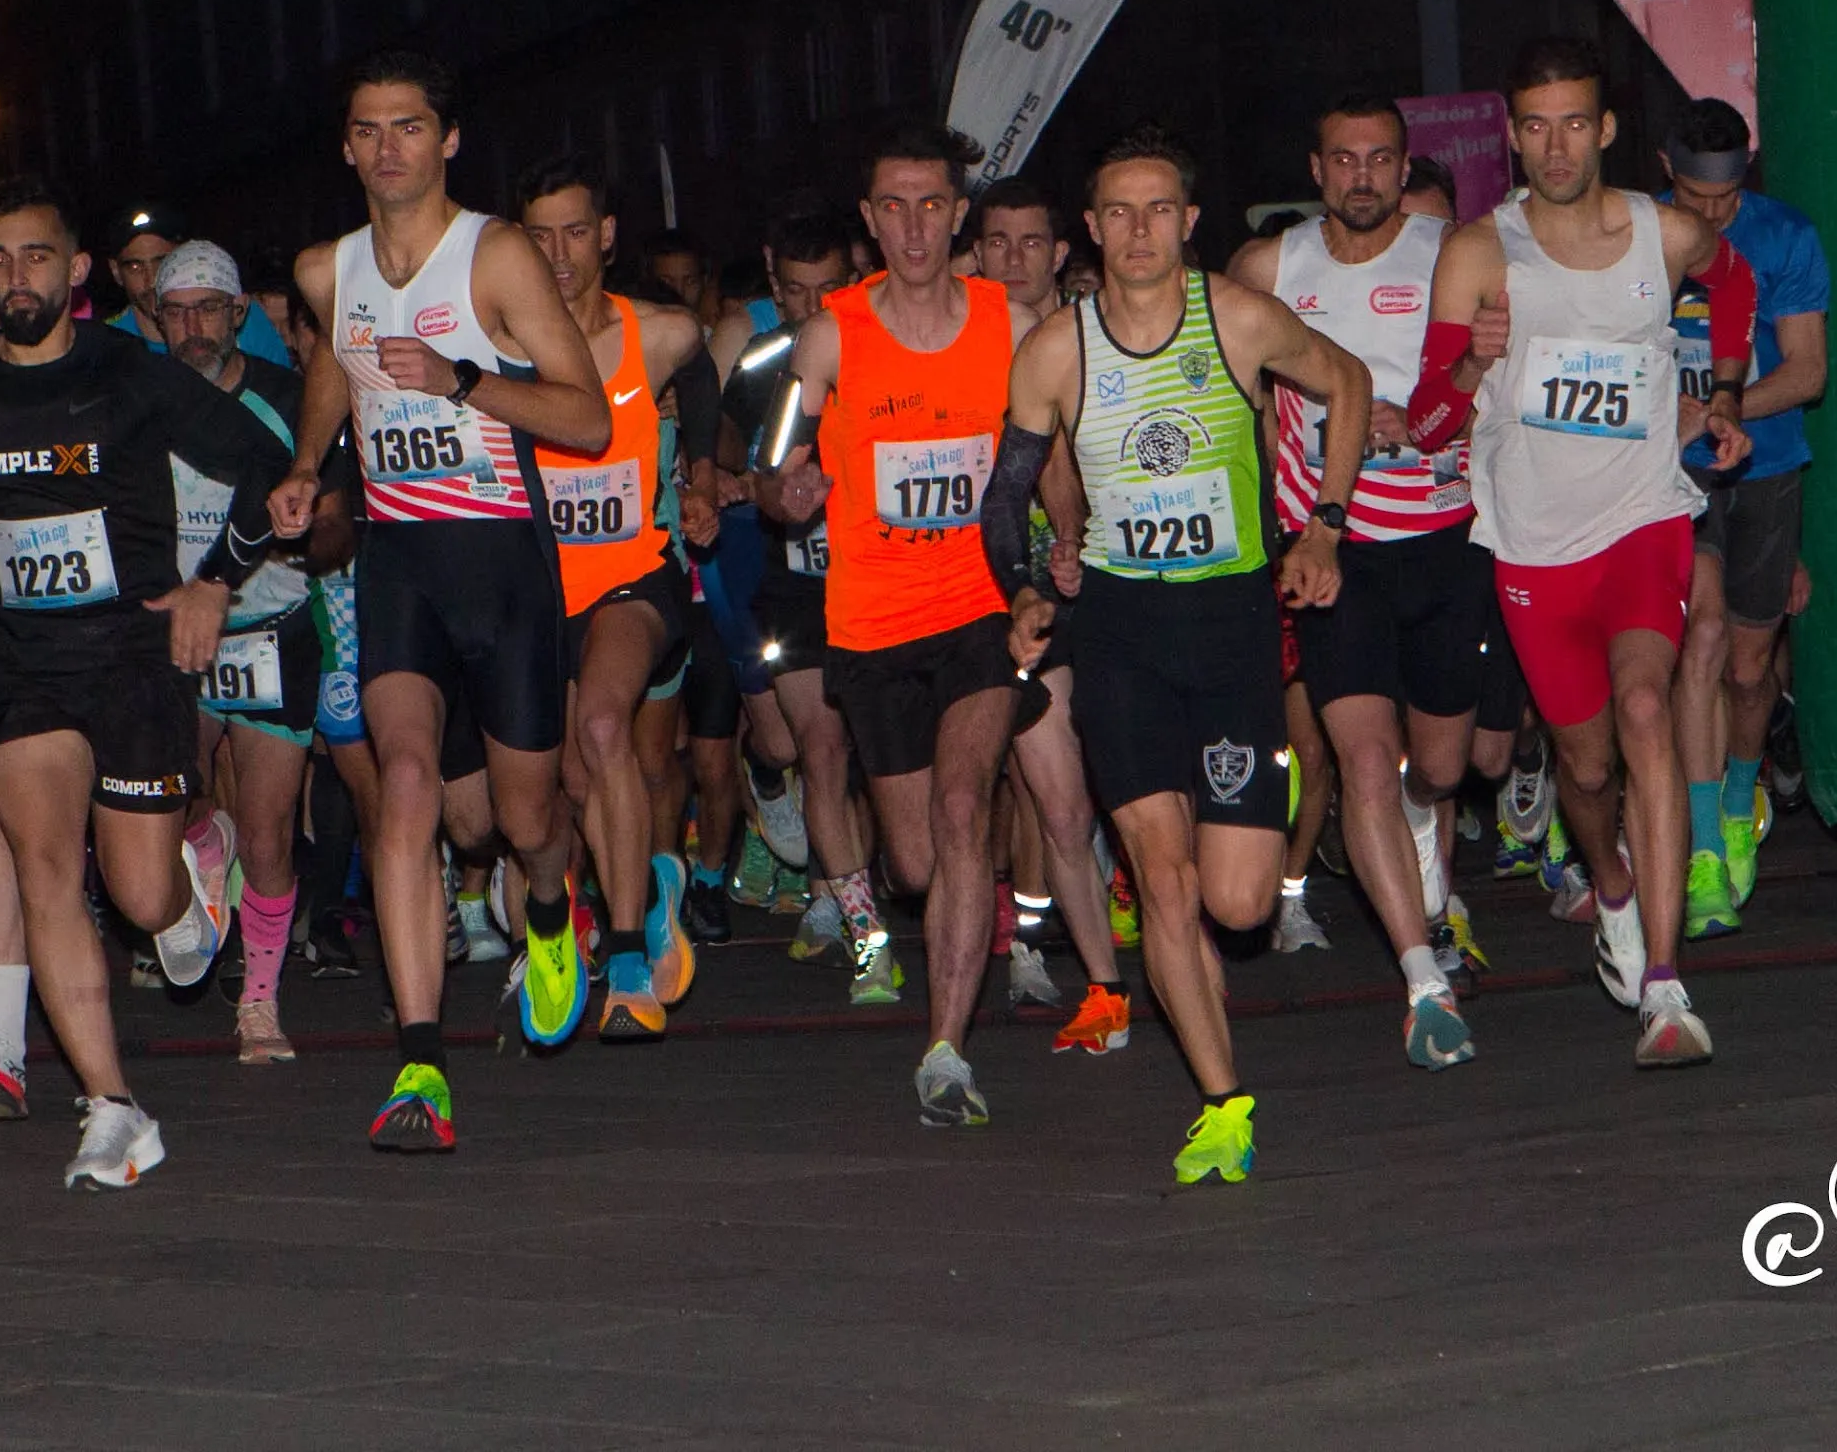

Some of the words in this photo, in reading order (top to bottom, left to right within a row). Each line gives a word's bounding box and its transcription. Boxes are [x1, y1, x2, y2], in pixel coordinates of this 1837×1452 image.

[1541, 376, 1630, 428] 1725
[87, 442, 100, 474] GYM
[370, 424, 465, 474] 1365
[547, 496, 624, 536] 930
[894, 473, 974, 518] 1779
[1115, 512, 1215, 560] 1229
[5, 550, 92, 598] 1223
